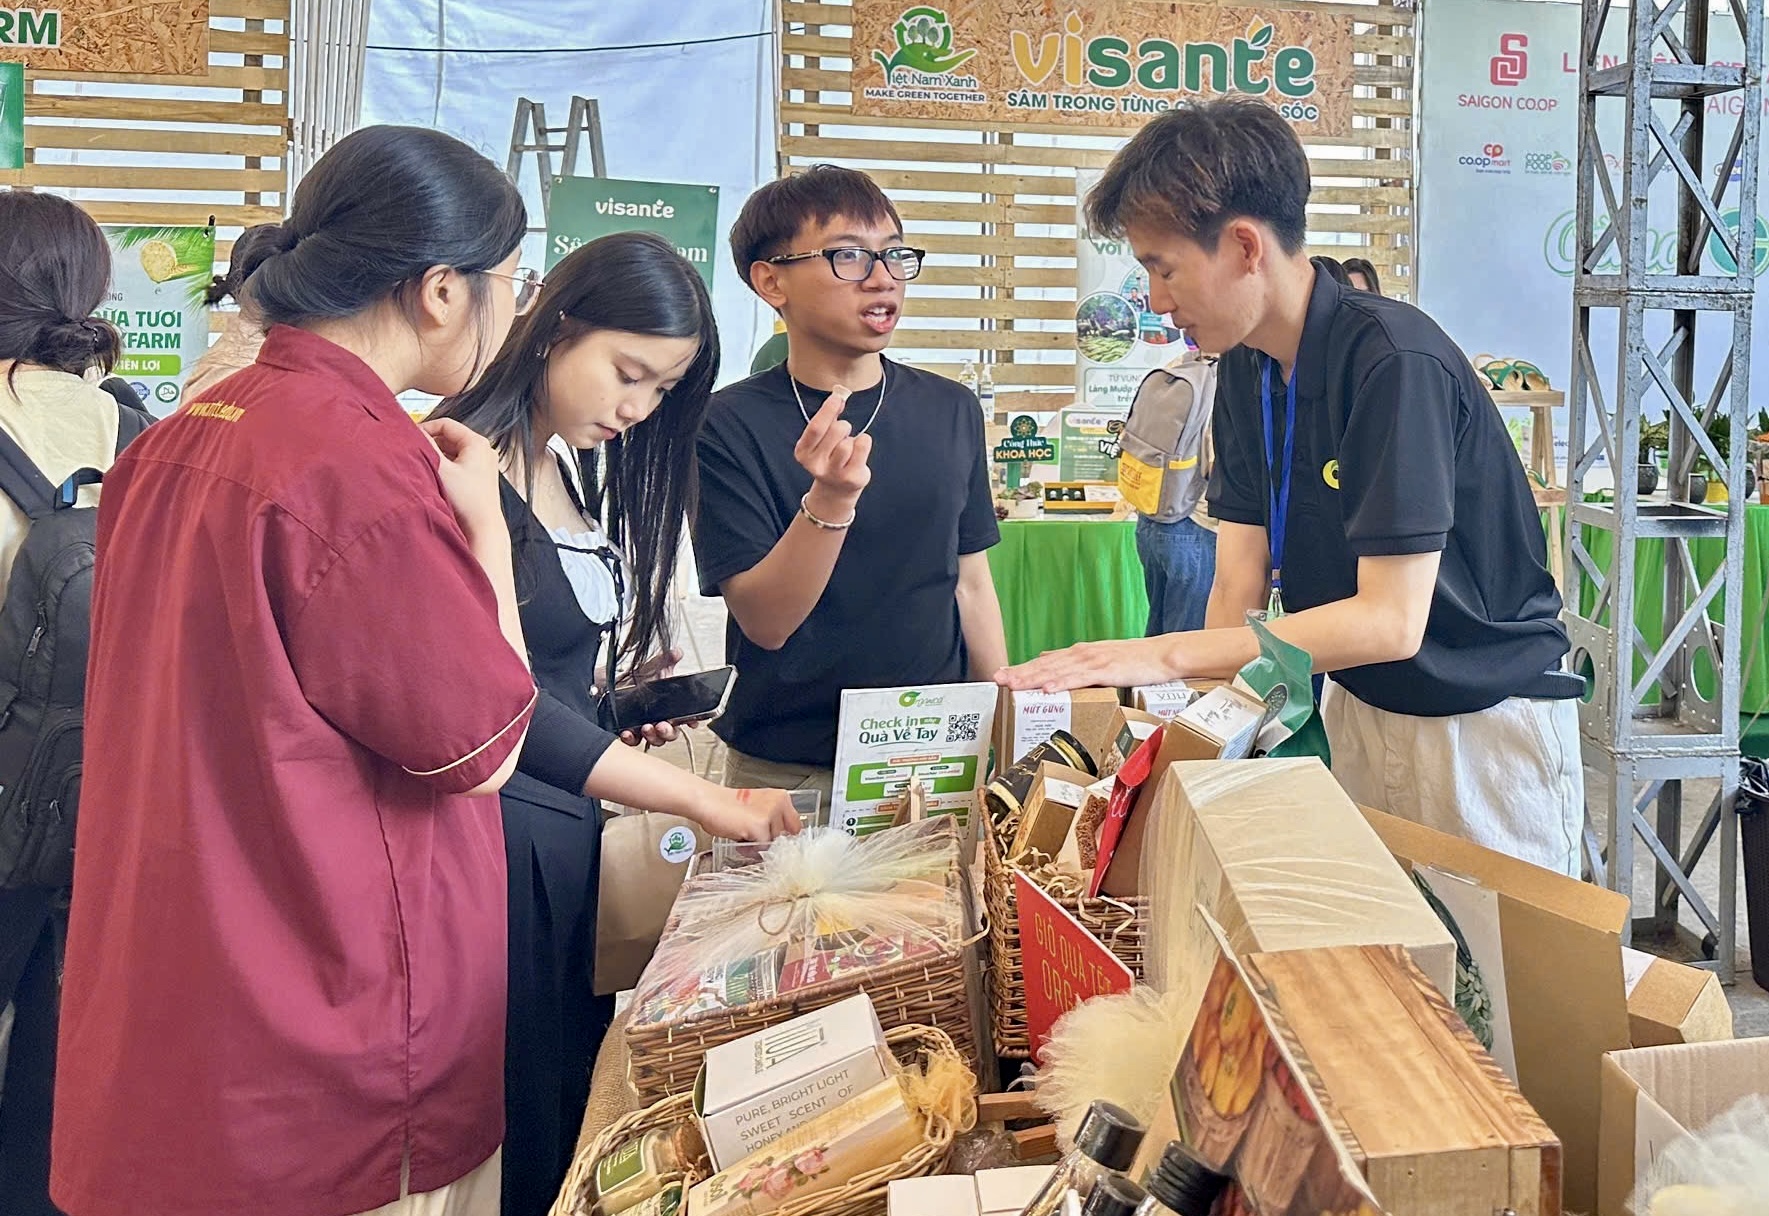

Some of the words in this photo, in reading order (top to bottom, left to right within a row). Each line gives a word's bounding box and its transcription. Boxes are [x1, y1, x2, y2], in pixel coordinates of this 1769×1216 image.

[1011, 11, 1315, 97] visante
[911, 74, 942, 86] Nam
[945, 75, 977, 88] Xanh
[865, 89, 894, 98] MAKE
[897, 90, 930, 99] GREEN
[933, 92, 985, 101] TOGETHER
[1458, 94, 1512, 109] SAIGON
[1517, 97, 1557, 111] CO.OP
[1007, 89, 1047, 108] SÂM
[1053, 95, 1116, 111] TRONG
[1281, 102, 1318, 120] SÓC
[595, 197, 675, 219] visante
[135, 310, 182, 327] TƯƠI
[995, 449, 1026, 460] KHOA
[1028, 448, 1052, 460] HỌC
[860, 716, 902, 731] Check
[906, 716, 918, 727] in
[858, 731, 888, 744] Quà
[893, 727, 911, 741] Về
[915, 727, 938, 741] Tay
[1059, 934, 1088, 989] QUÀ
[735, 1104, 771, 1126] PURE,
[771, 1083, 816, 1110] BRIGHT
[816, 1068, 850, 1091] LIGHT
[740, 1115, 782, 1141] SWEET
[788, 1095, 828, 1120] SCENT
[837, 1084, 855, 1099] OF
